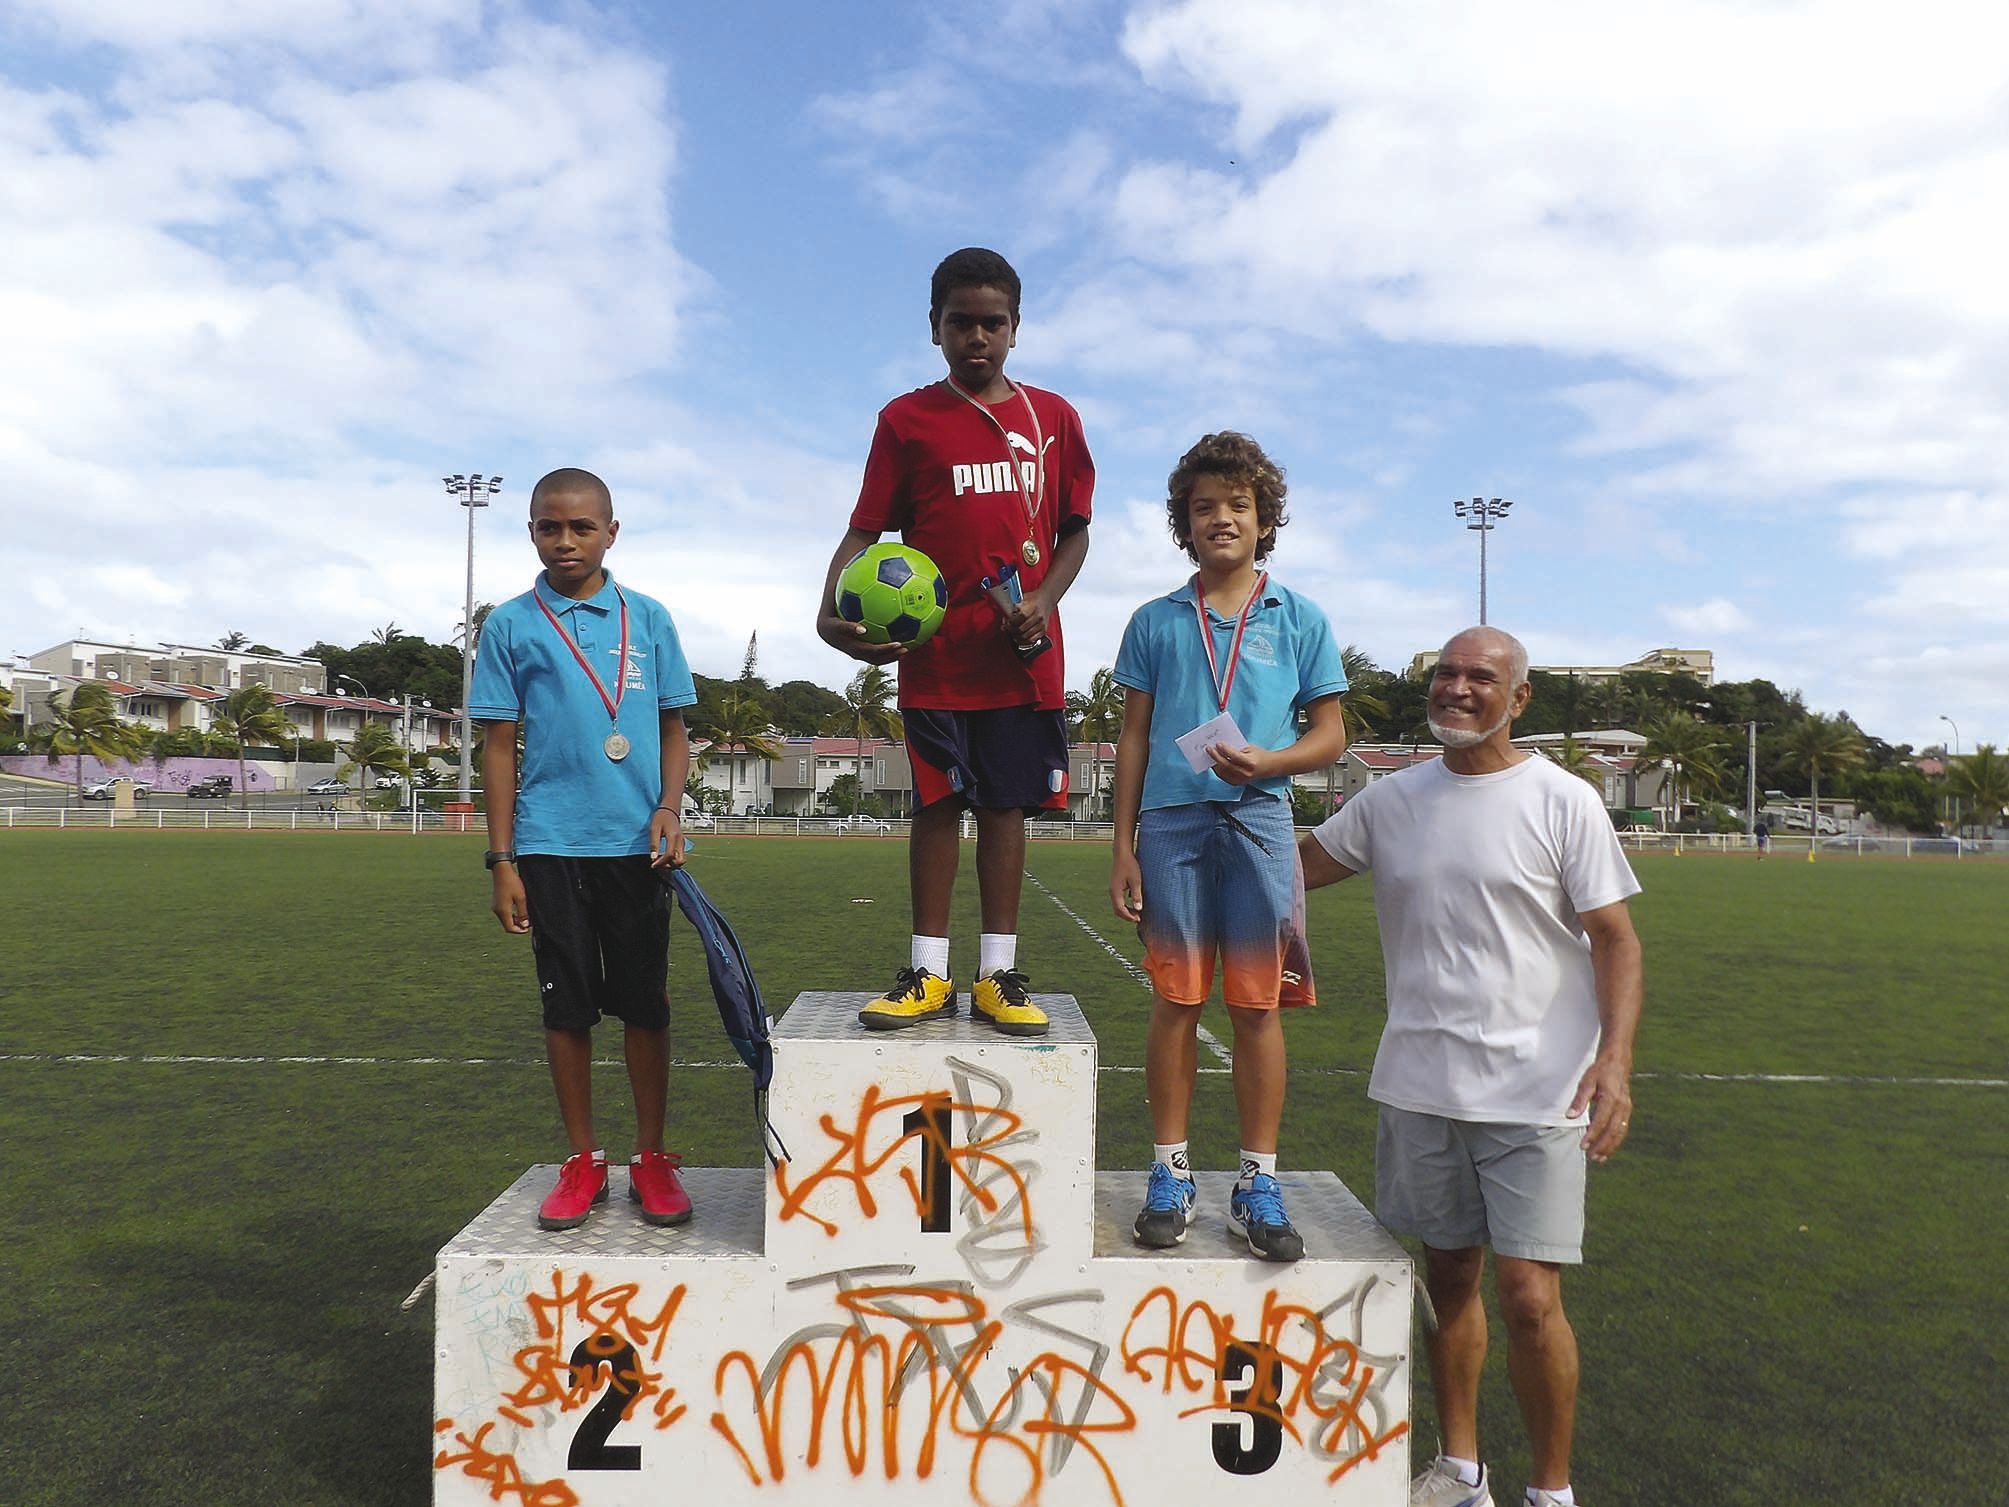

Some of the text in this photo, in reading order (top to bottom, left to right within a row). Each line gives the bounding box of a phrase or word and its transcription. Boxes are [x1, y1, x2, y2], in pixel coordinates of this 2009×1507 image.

[903, 1097, 951, 1232] 1
[567, 1335, 642, 1470] 2
[1211, 1341, 1283, 1475] 3
